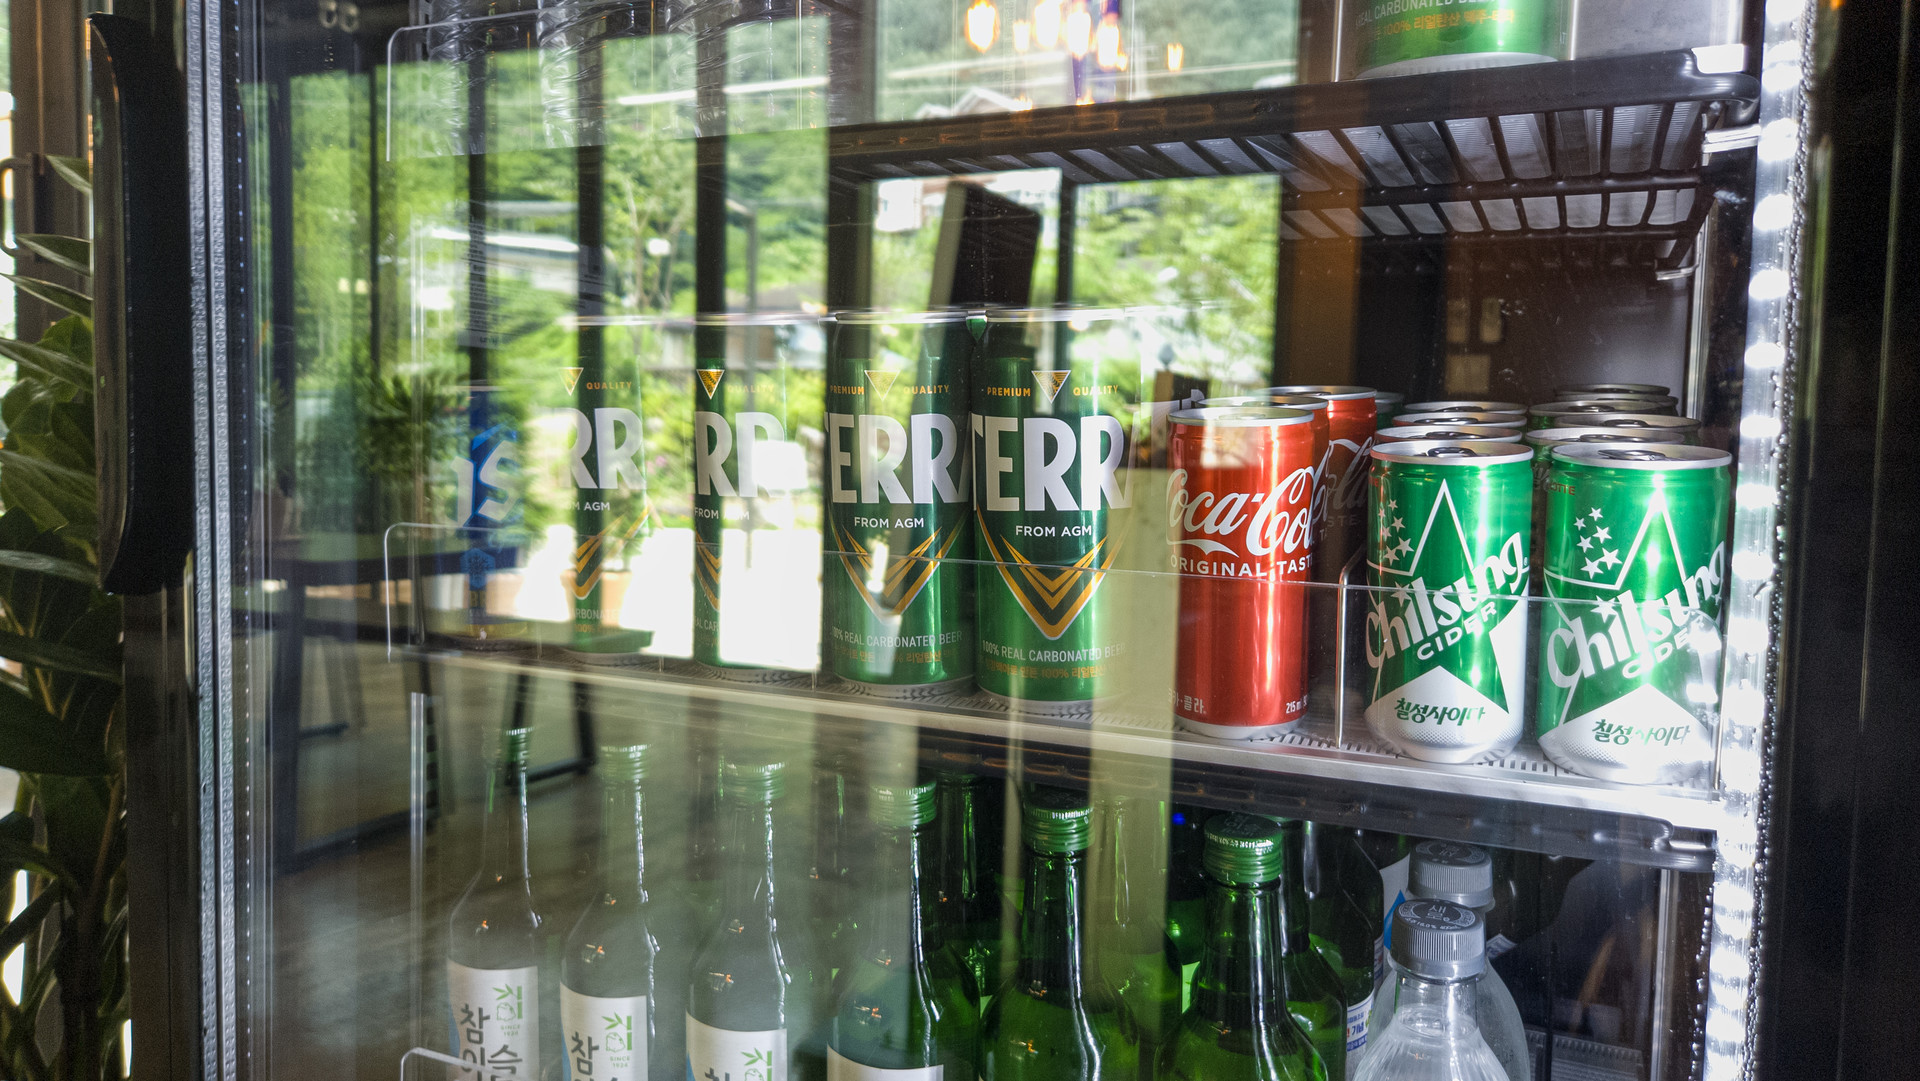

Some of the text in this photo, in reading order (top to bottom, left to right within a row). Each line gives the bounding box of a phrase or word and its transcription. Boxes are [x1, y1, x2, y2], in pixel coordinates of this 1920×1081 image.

[586, 381, 632, 390] QUALITY
[829, 384, 949, 396] PREMIUM QUALITY
[986, 385, 1119, 397] PREMIUM QUALITY
[584, 502, 611, 511] AGM
[854, 516, 925, 528] FROM AGM
[1015, 525, 1093, 538] FROM AGM
[1169, 552, 1314, 578] ORIGINAL TAST
[1366, 532, 1530, 669] Chilsung
[1547, 540, 1725, 688] Chilsung
[844, 630, 865, 646] REAL
[866, 634, 936, 648] CARBONATED
[1417, 601, 1498, 661] CIDER
[1001, 645, 1026, 661] REAL
[1028, 649, 1102, 663] CARBONATED
[1394, 697, 1486, 726] 칠성사이다
[1592, 719, 1691, 747] 칠성사이다
